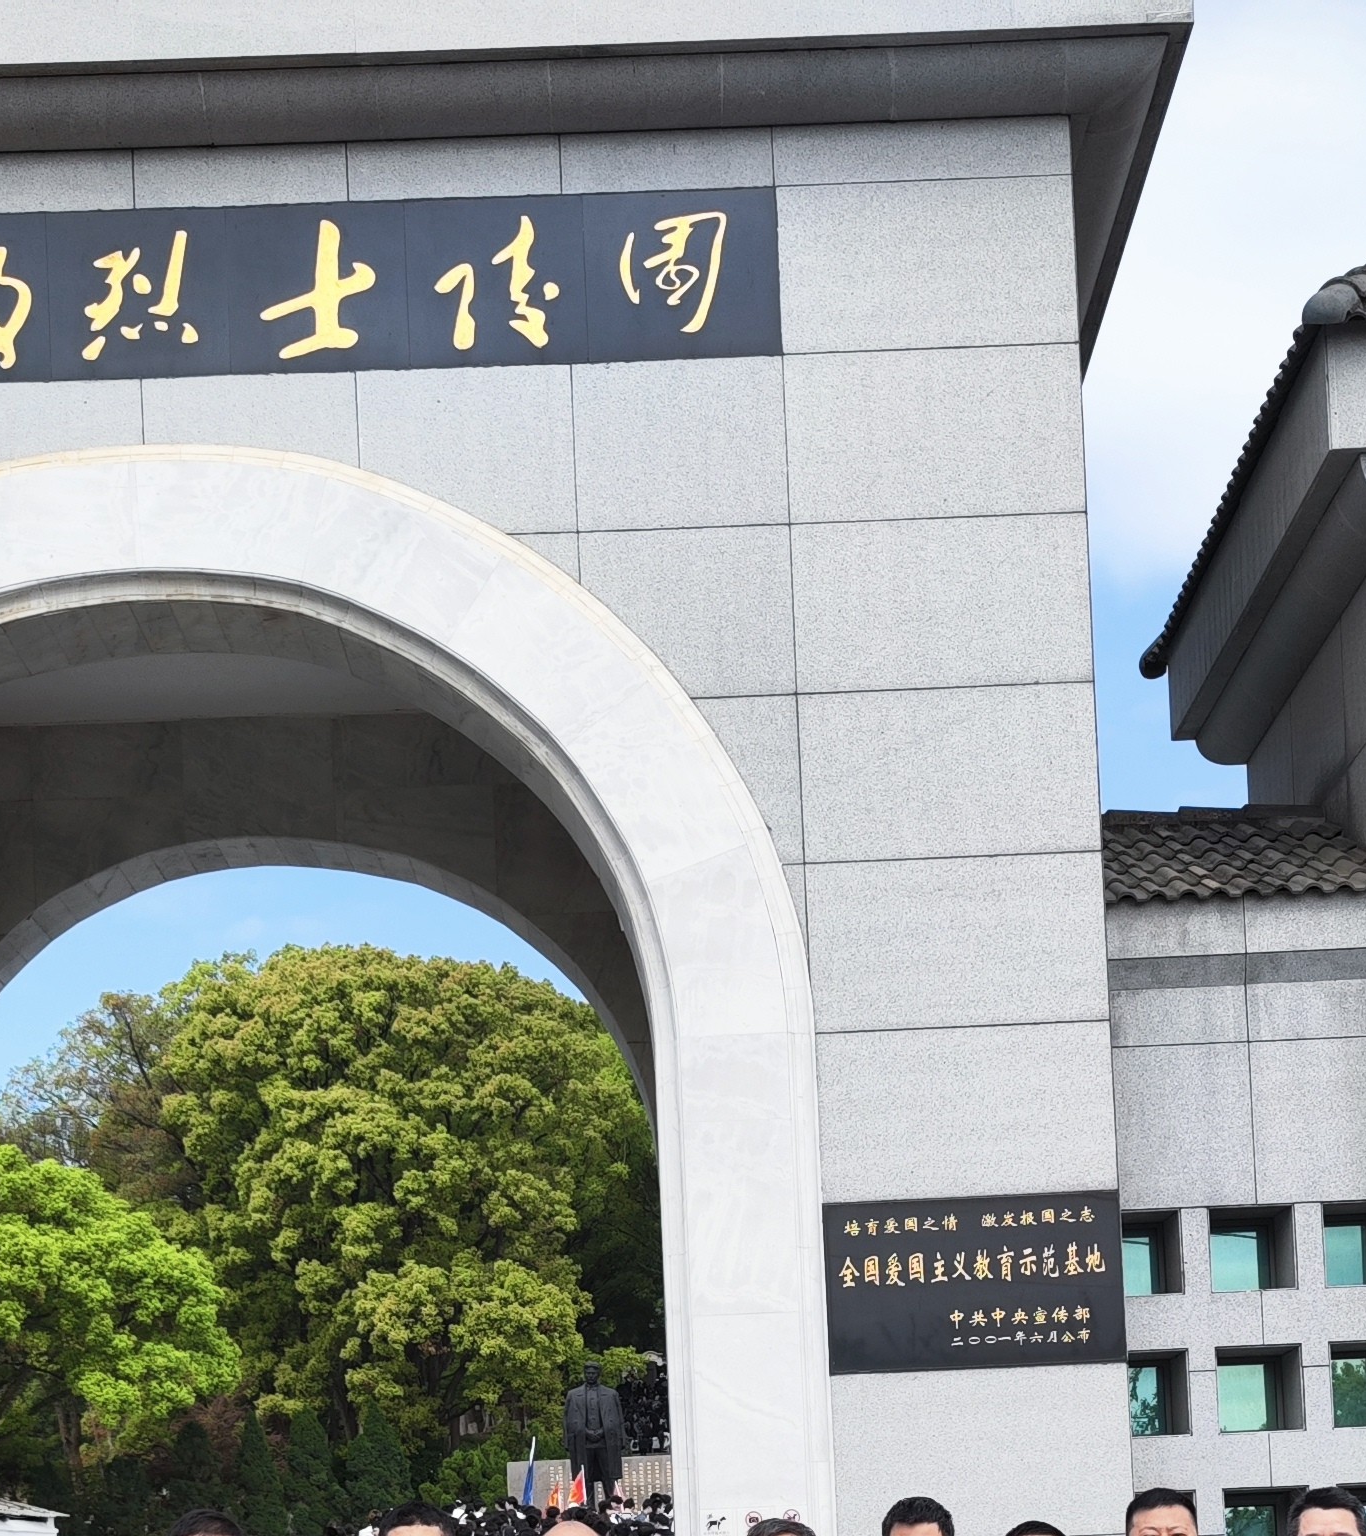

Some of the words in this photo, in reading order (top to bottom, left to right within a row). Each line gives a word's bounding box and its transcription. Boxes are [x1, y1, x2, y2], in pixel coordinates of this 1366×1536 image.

[843, 1212, 959, 1238] 培育爱国之情
[981, 1205, 1096, 1229] 激发报国之志
[838, 1241, 1107, 1288] 全国爱国主义教育示范基地
[949, 1304, 1091, 1330] 中共中央宣传部
